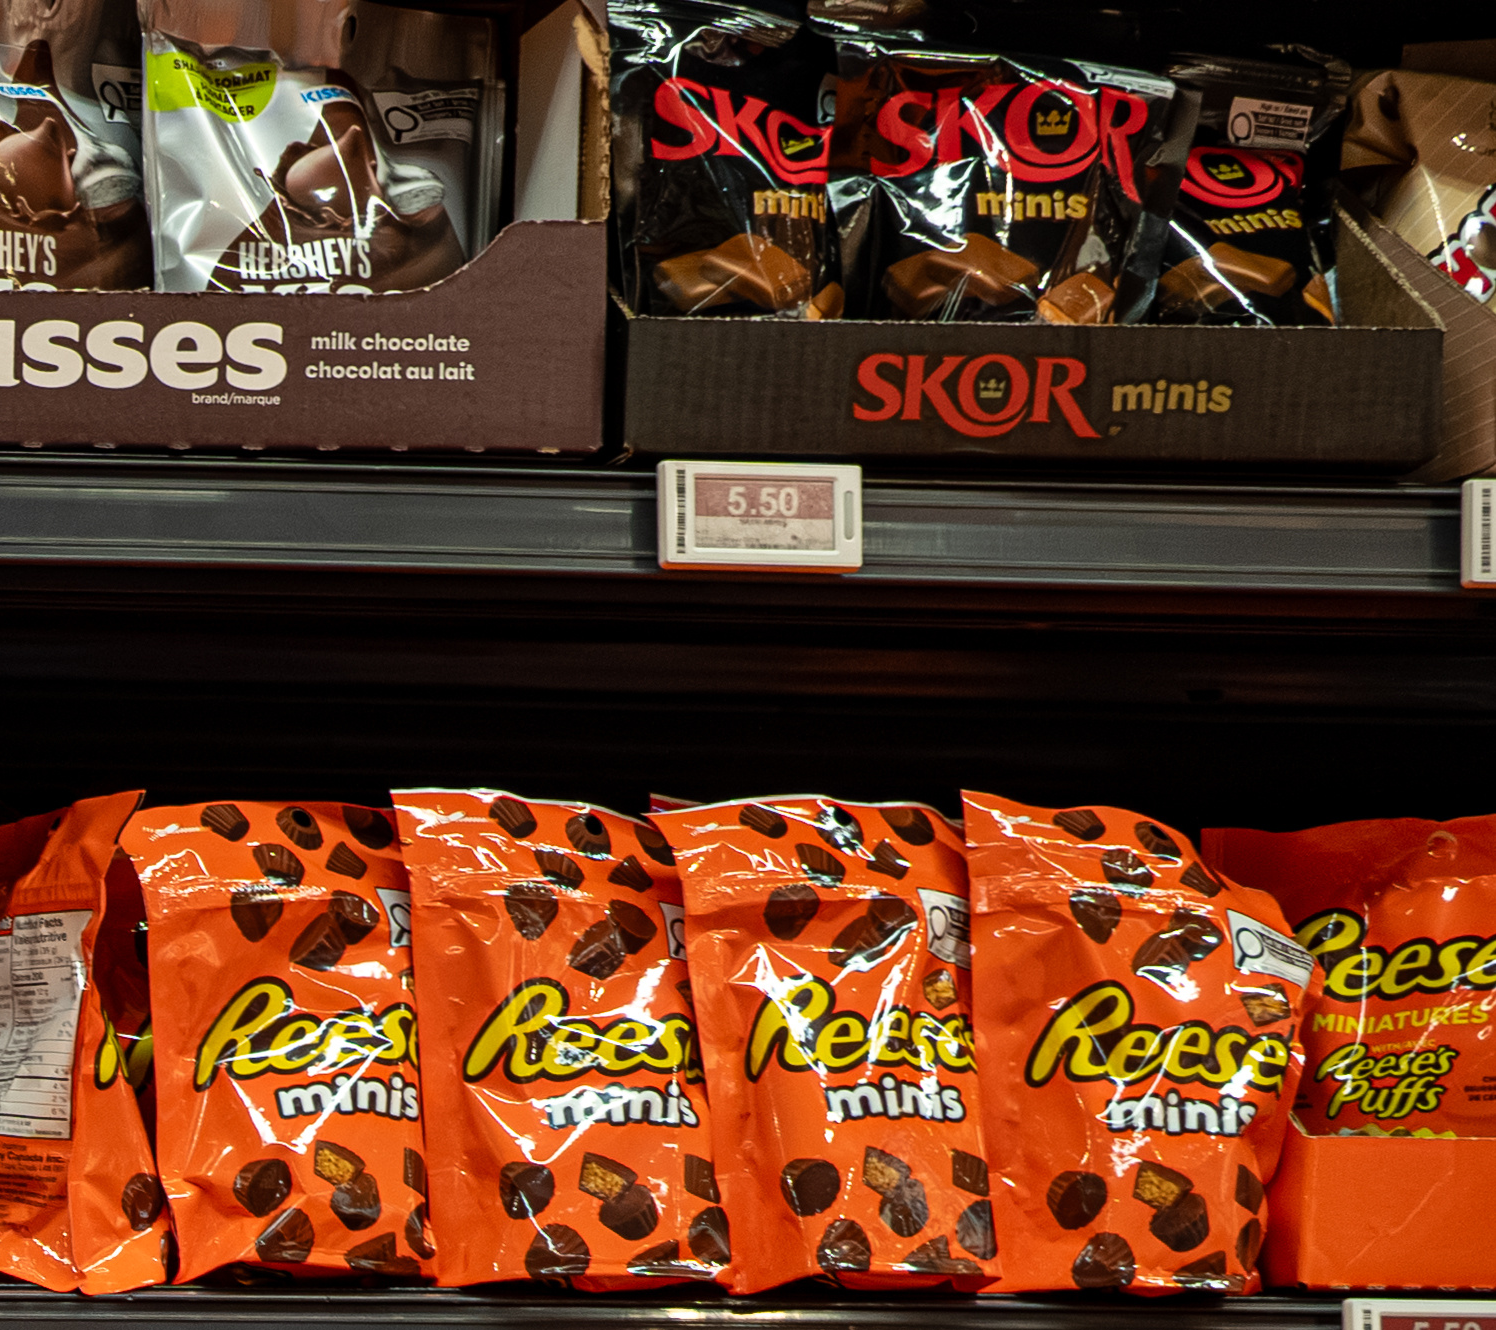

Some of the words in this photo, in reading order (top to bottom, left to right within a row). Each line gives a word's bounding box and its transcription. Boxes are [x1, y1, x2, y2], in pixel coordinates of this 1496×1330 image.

[311, 333, 355, 352] milk
[361, 333, 470, 354] chocolate
[305, 361, 400, 382] chocolat
[406, 365, 430, 381] au
[436, 361, 474, 382] lait
[854, 353, 1101, 438] SKOR
[1112, 381, 1232, 414] minis
[728, 487, 799, 516] 5.50
